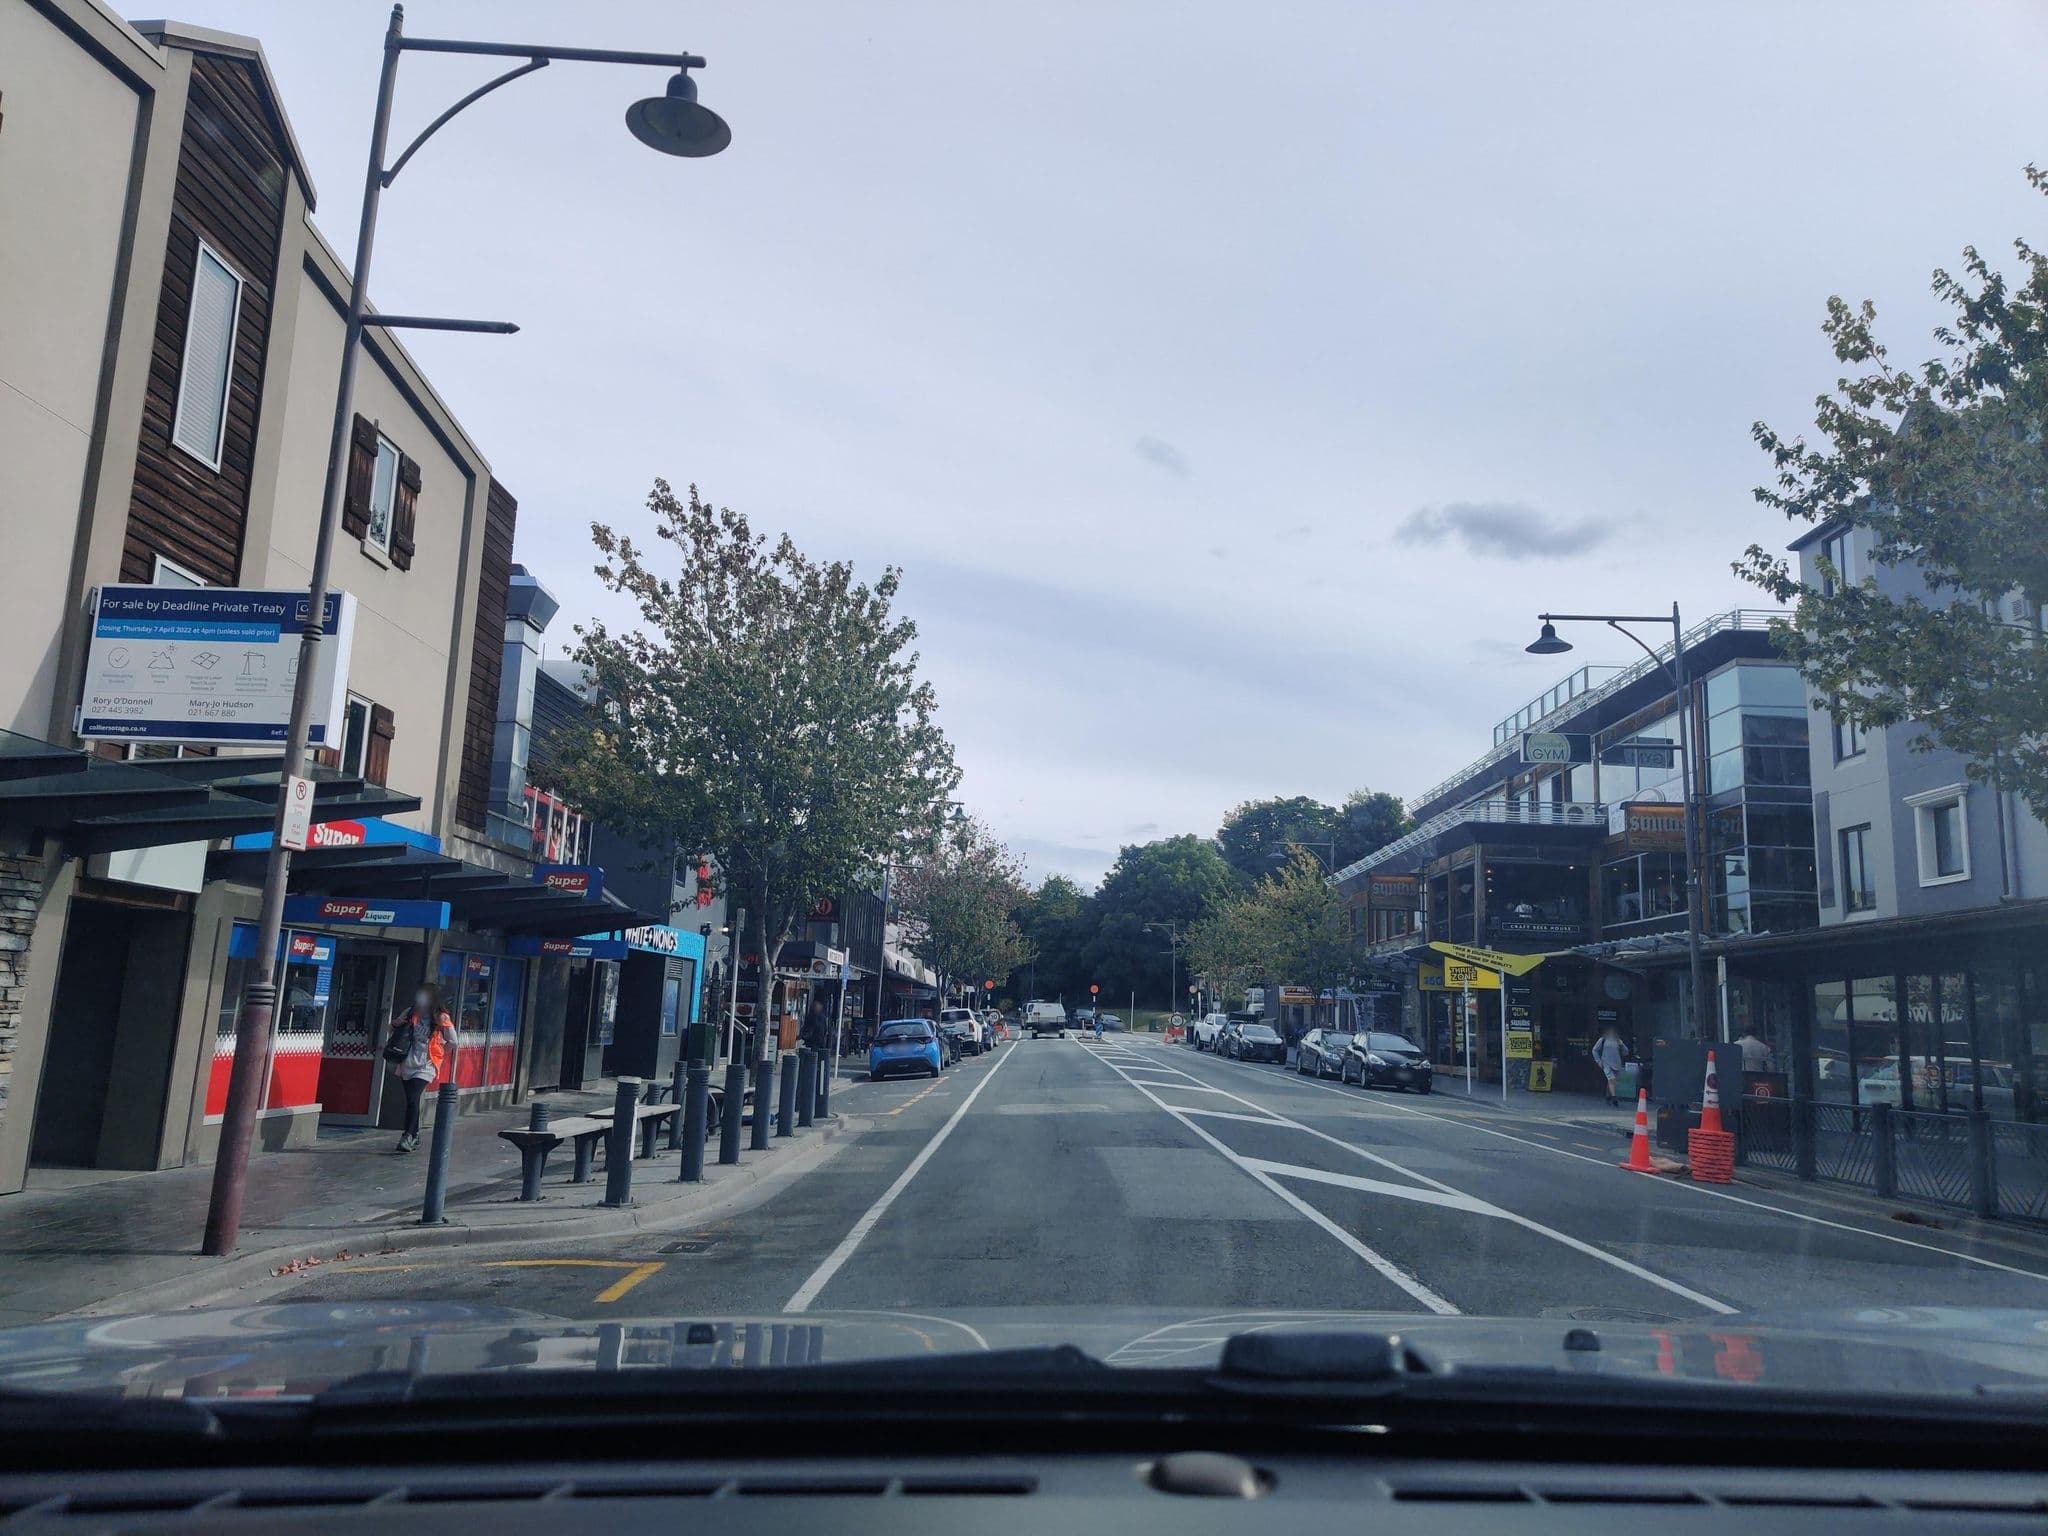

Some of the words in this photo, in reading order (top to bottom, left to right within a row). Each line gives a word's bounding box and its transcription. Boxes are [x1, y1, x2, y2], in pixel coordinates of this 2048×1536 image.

[102, 599, 120, 608] For
[122, 600, 144, 610] sale
[146, 600, 160, 612] by
[162, 600, 210, 612] Deadline
[212, 602, 250, 613] Private
[252, 603, 286, 616] Treaty
[122, 625, 152, 635] Thursday
[158, 626, 175, 635] April
[200, 628, 216, 636] 4pm
[216, 628, 241, 636] (unless
[256, 629, 275, 638] prior)
[93, 696, 112, 706] Rory
[113, 697, 154, 706] O'Donnell
[222, 701, 254, 709] Hudson
[204, 709, 220, 717] 667
[1532, 748, 1565, 761] GYM
[313, 822, 359, 846] Super
[546, 875, 585, 887] Super
[324, 902, 363, 916] Super
[365, 912, 392, 921] Liquor
[293, 938, 315, 953] Super
[543, 942, 570, 952] Super
